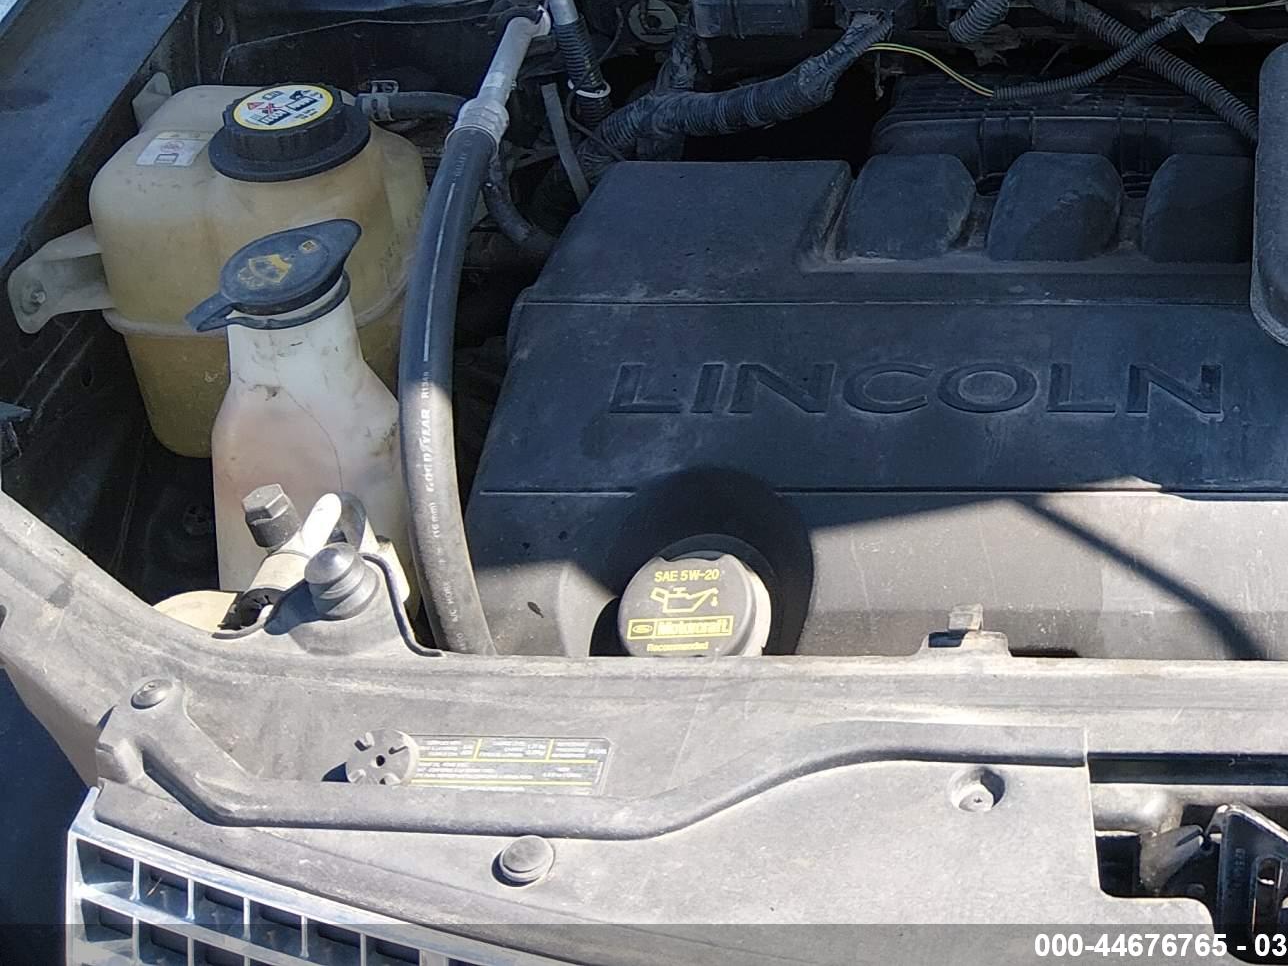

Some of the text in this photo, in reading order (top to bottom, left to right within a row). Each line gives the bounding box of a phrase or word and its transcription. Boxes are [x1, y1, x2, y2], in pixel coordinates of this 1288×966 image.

[608, 362, 1226, 417] LINCOLN
[654, 568, 720, 583] SAE 5W-20
